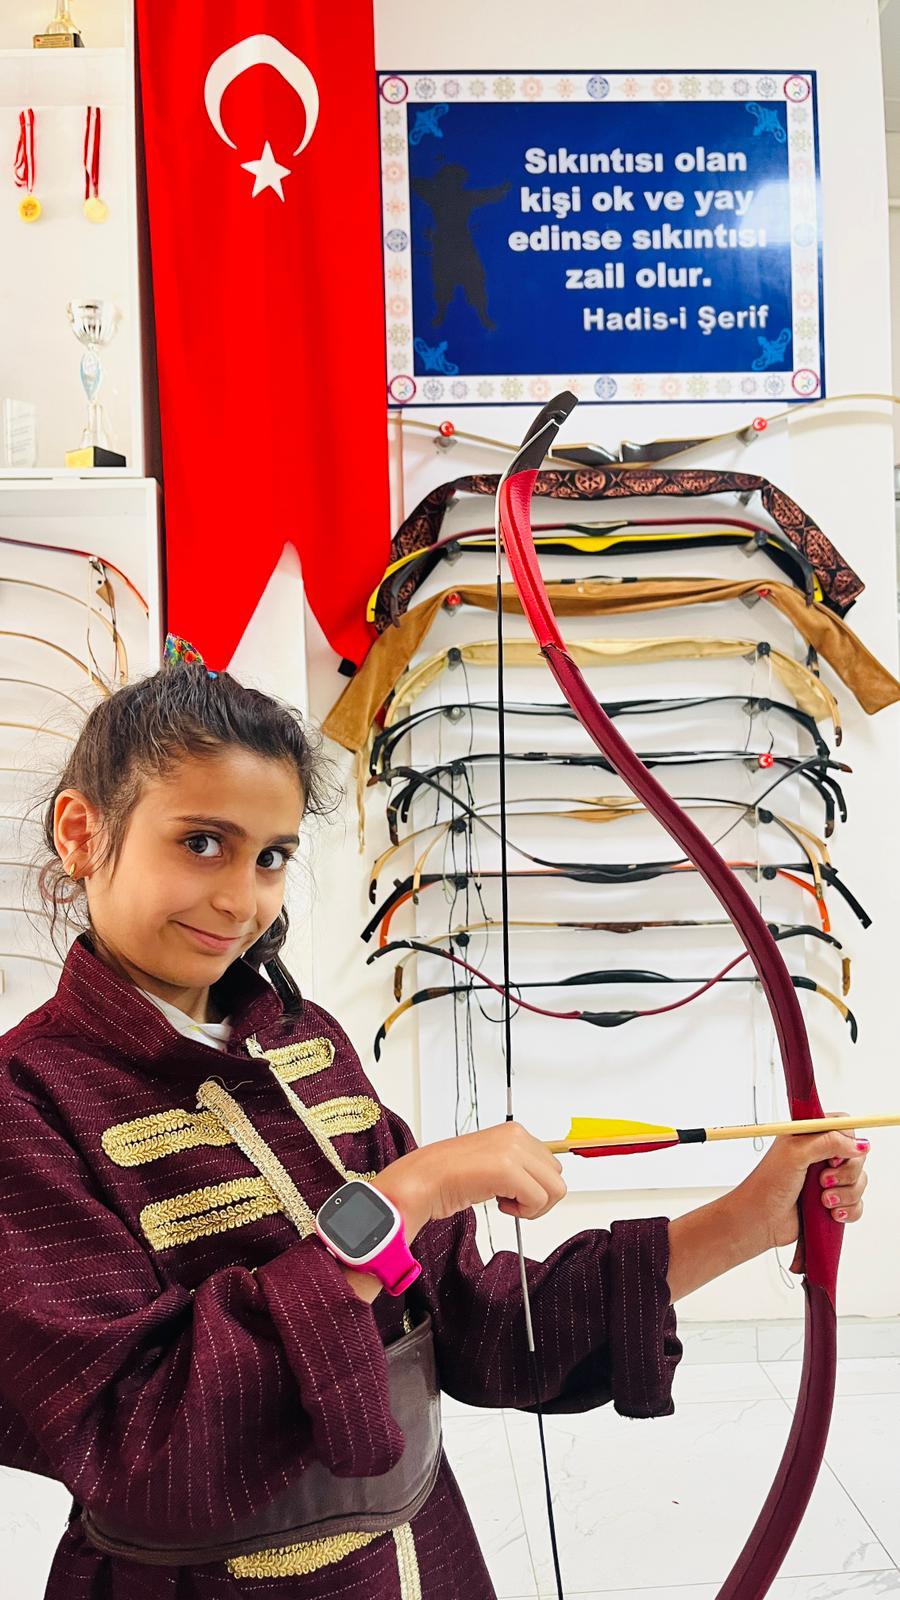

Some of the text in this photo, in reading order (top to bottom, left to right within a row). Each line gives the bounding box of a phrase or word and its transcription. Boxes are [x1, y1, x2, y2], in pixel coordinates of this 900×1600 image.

[525, 146, 747, 174] Sıkıntısı olan
[520, 185, 754, 219] kişi ok ve yay
[508, 223, 767, 251] edinse sıkıntısı
[565, 262, 712, 289] zail olur.
[583, 305, 769, 335] Hadis-i Şerif
